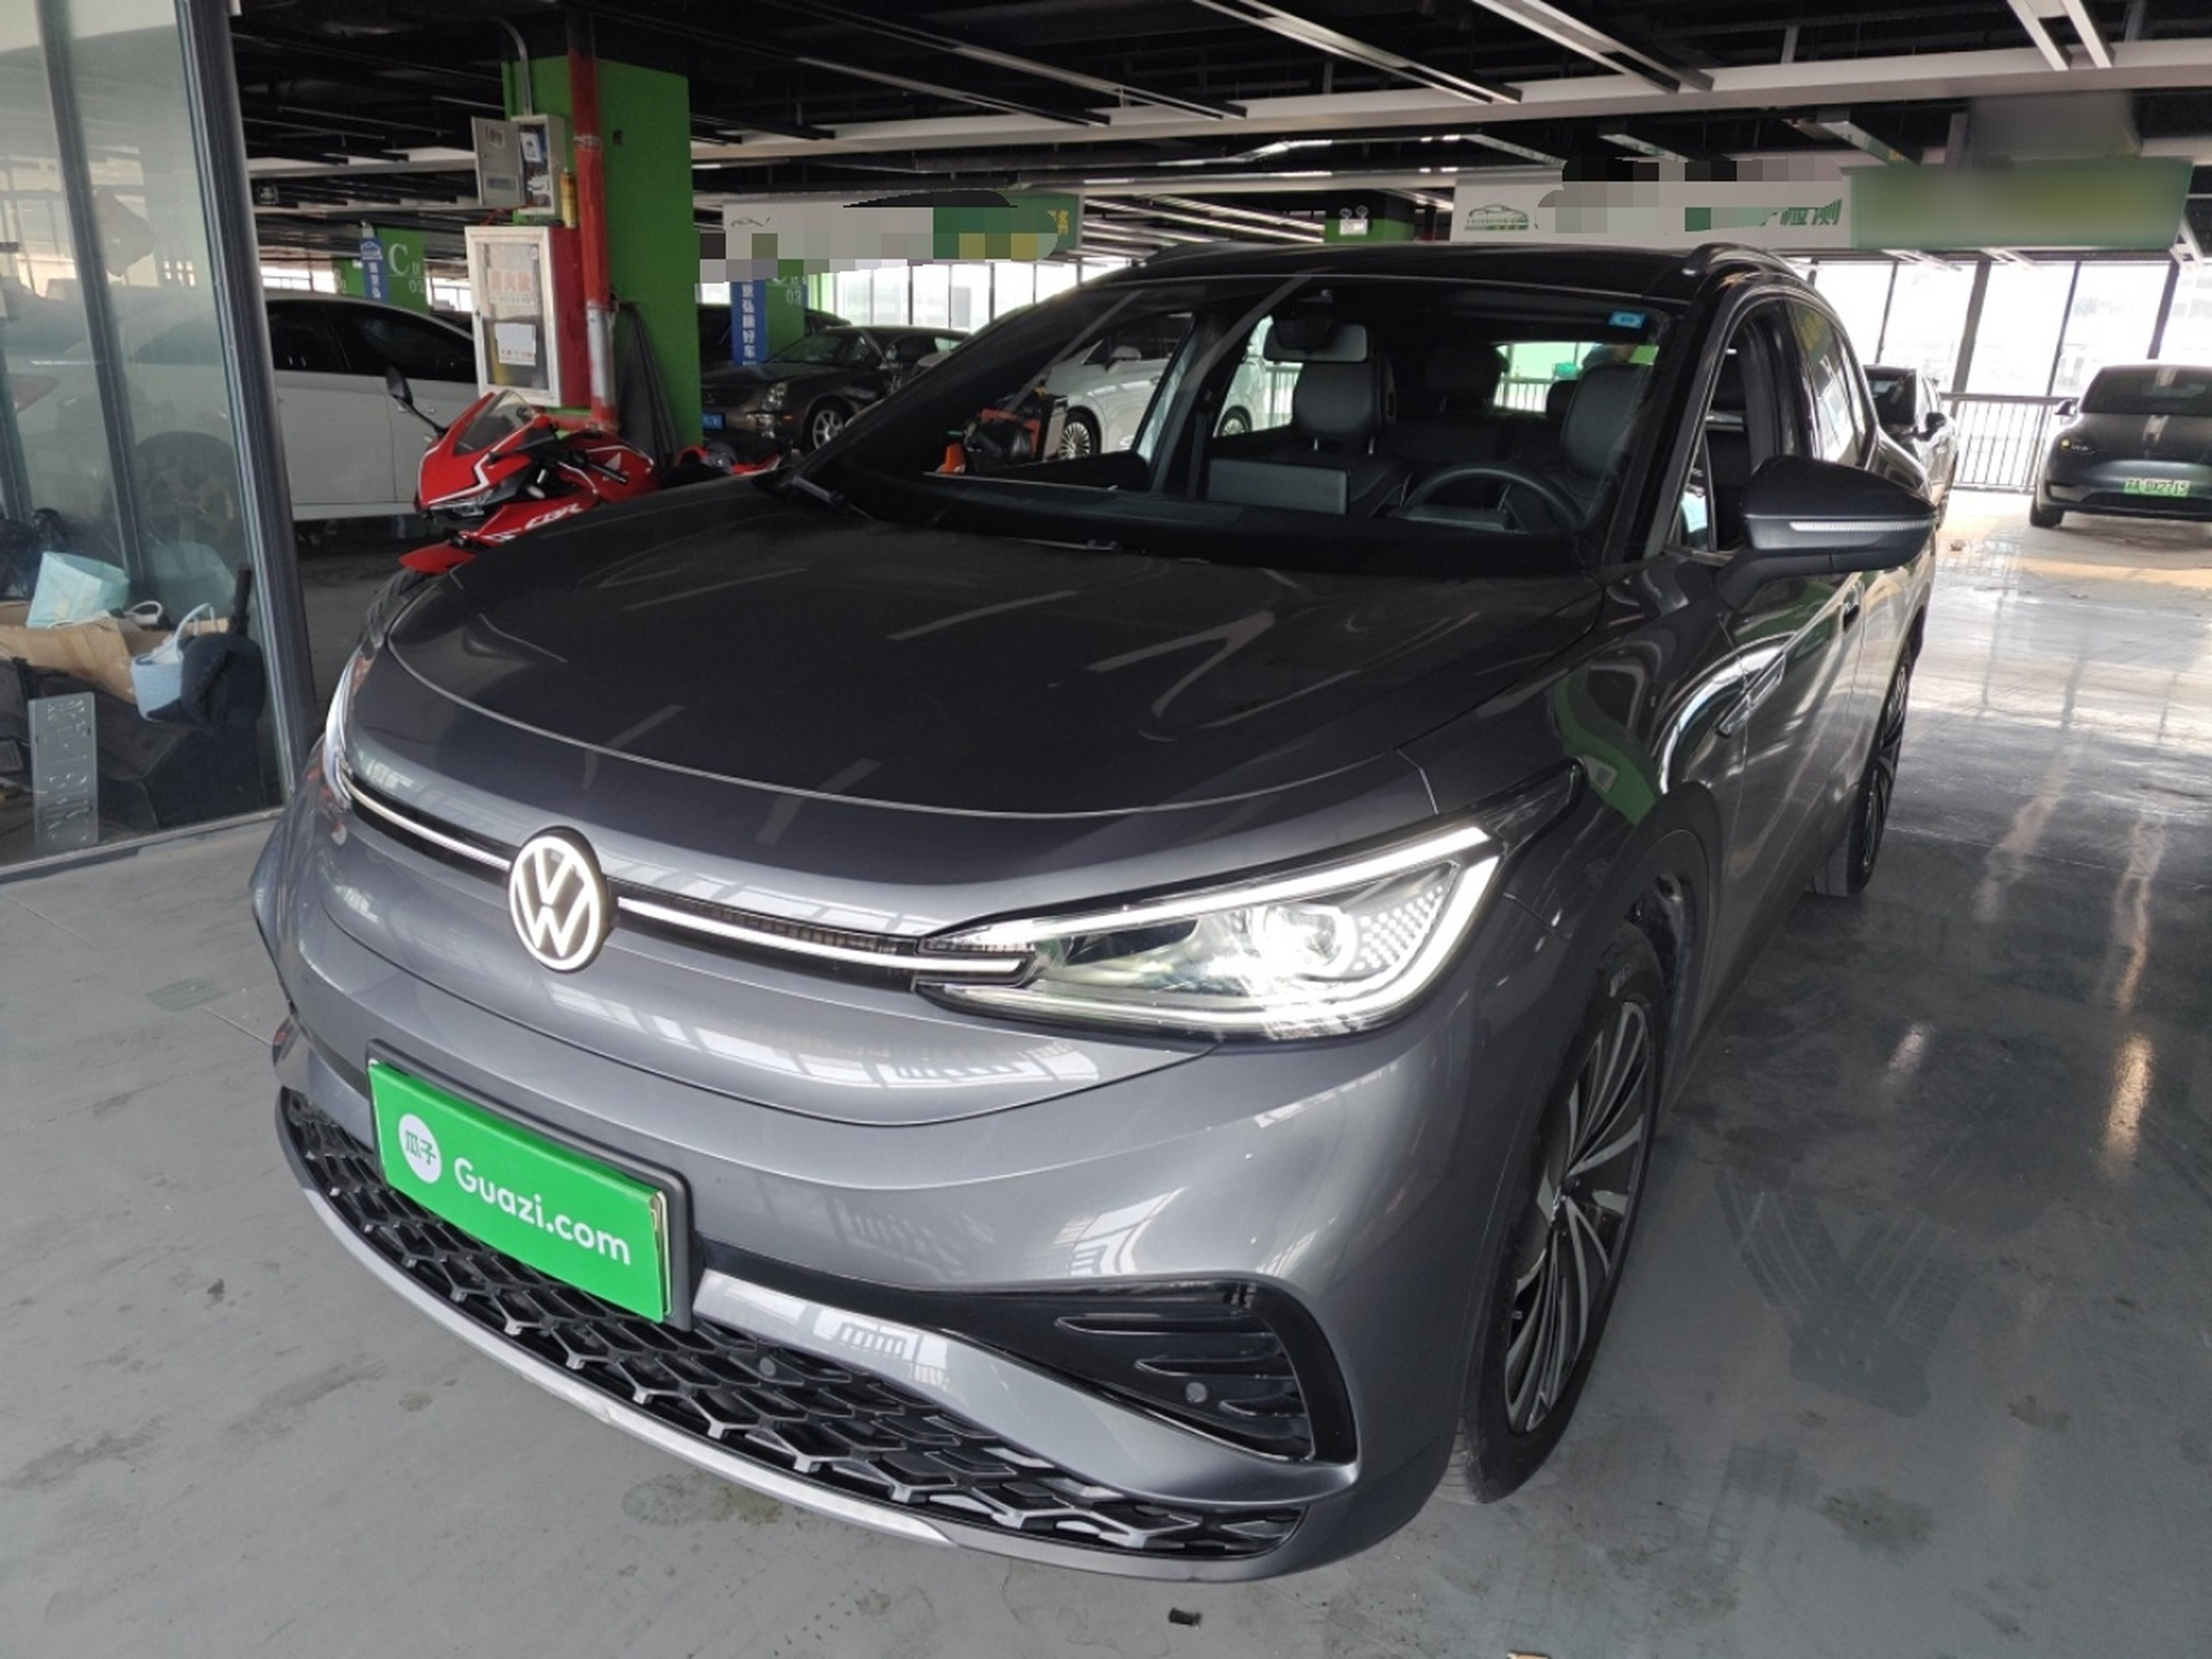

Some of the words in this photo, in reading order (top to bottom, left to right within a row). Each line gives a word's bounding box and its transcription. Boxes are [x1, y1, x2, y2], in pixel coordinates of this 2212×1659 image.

[786, 289, 802, 305] 03
[404, 1130, 437, 1166] 瓜子
[453, 1157, 632, 1266] Guazi.com
